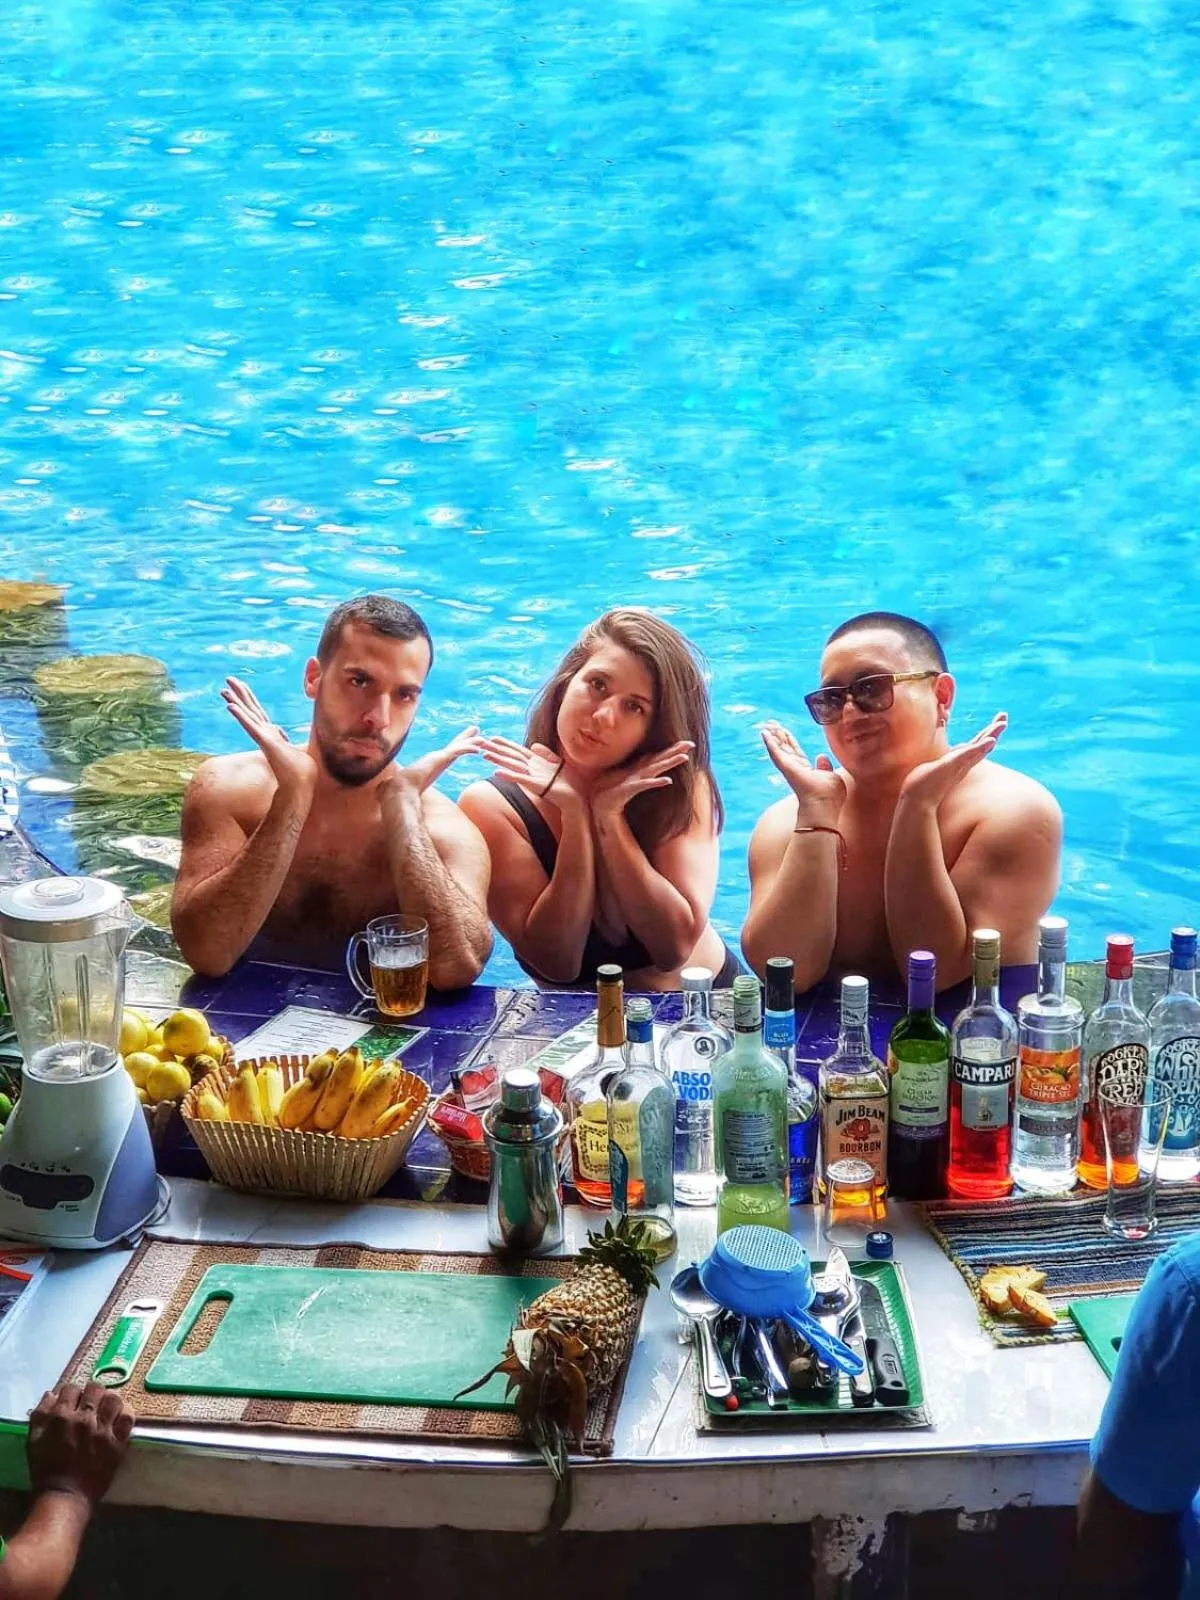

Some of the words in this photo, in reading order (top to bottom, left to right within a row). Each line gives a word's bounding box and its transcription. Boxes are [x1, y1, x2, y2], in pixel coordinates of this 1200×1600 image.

[672, 1071, 711, 1086] ABSO
[955, 1061, 1015, 1083] CAMPARI
[679, 1086, 712, 1100] VOD
[835, 1108, 856, 1126] JIM
[858, 1104, 885, 1122] BEAM
[840, 1141, 882, 1153] BOURBON
